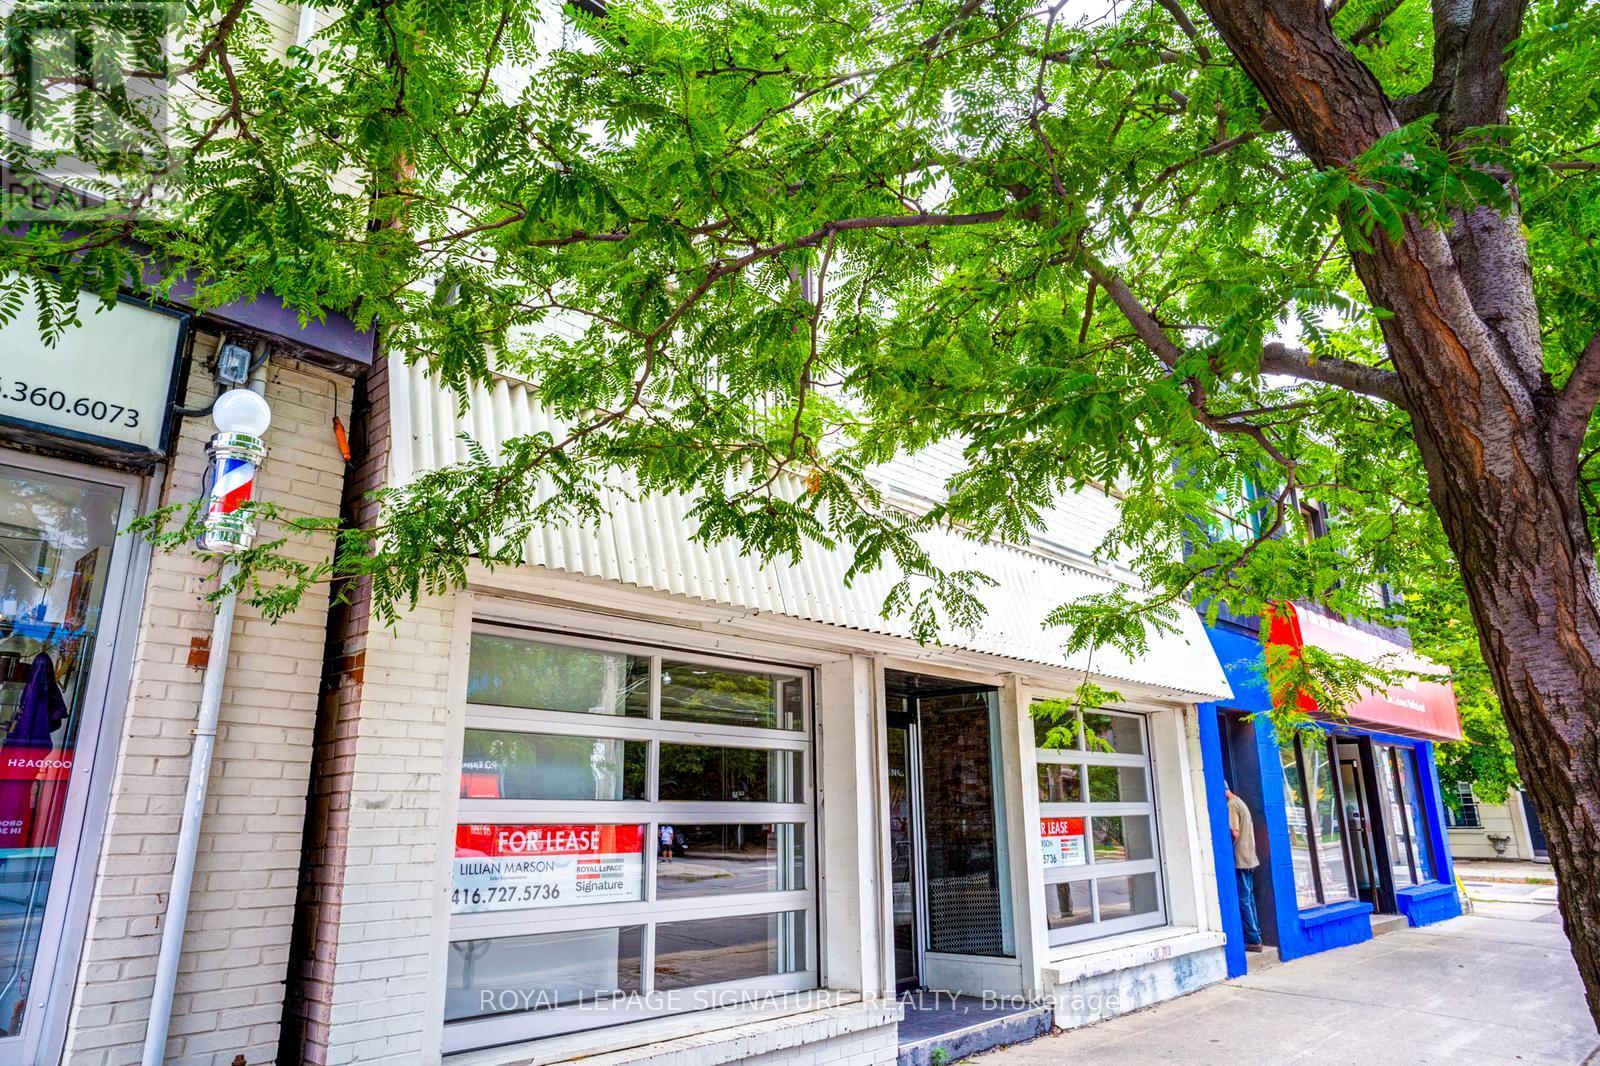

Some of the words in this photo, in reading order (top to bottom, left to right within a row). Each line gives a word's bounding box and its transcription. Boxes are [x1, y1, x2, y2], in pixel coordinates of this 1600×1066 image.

[1047, 821, 1069, 834] LEASE
[498, 831, 540, 852] FOR
[546, 830, 600, 851] LEASE
[1043, 853, 1058, 864] 5736
[460, 862, 501, 875] LILLIAN
[504, 861, 555, 873] MARSON
[575, 880, 624, 893] Signature
[451, 883, 561, 905] 416.727.5736
